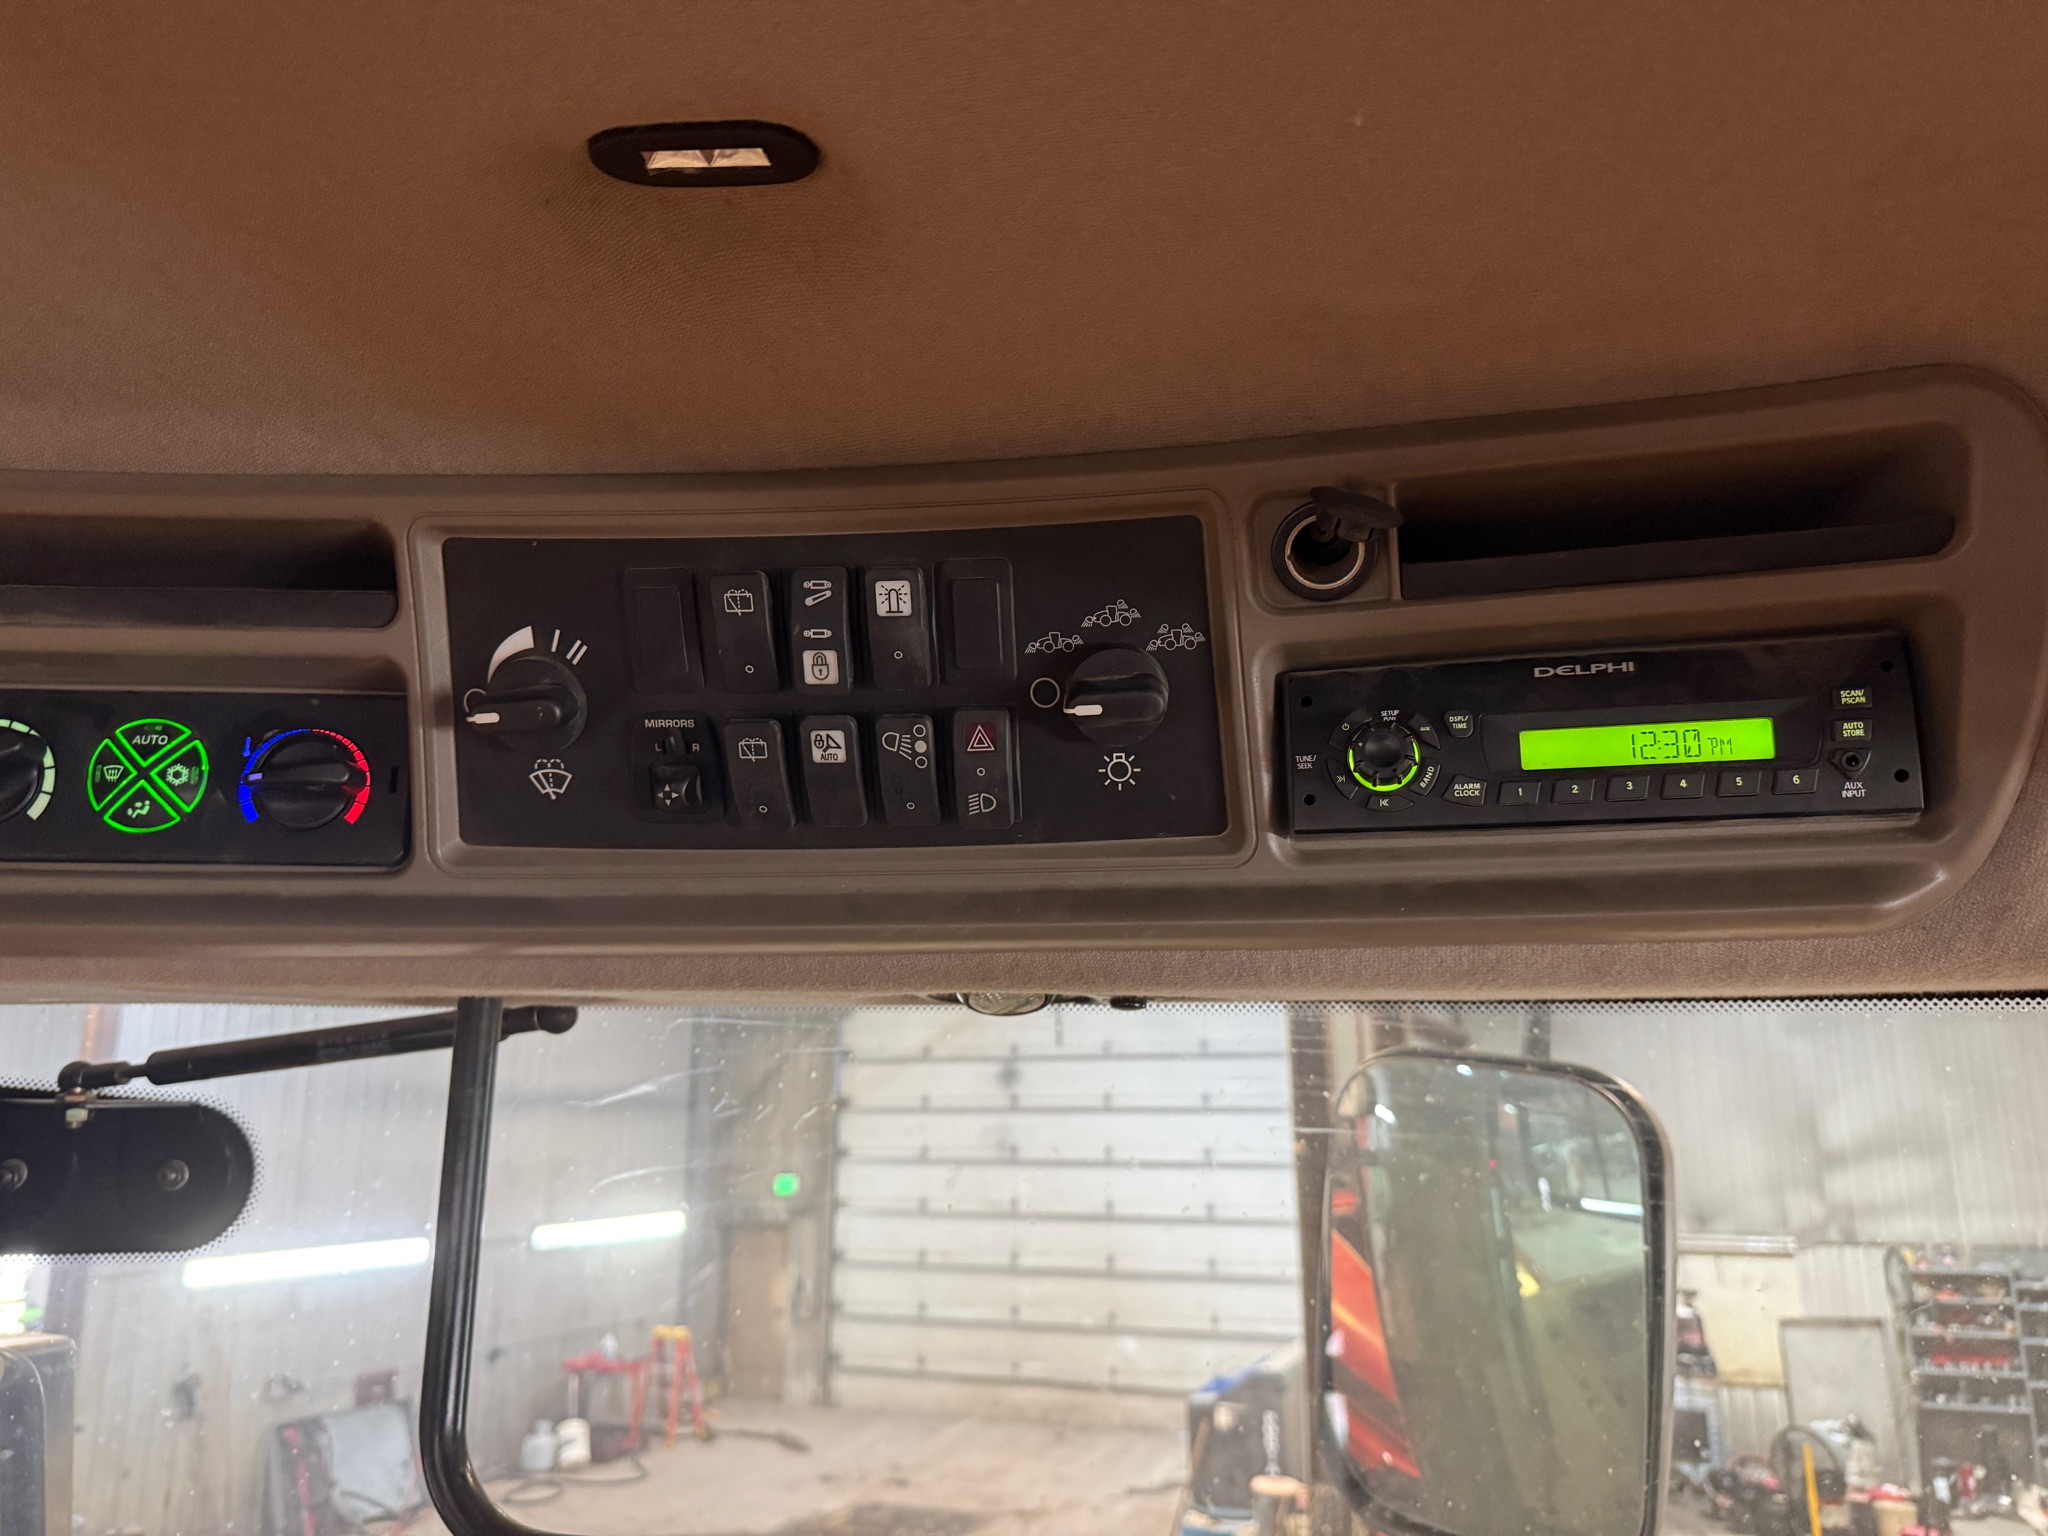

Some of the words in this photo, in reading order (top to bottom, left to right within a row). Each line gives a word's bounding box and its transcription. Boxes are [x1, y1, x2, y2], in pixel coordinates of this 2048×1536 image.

[1533, 661, 1635, 678] DELPHI
[1840, 689, 1865, 698] SCAN/
[1841, 696, 1866, 705] PSCAN
[1380, 709, 1400, 717] SETUP
[644, 719, 695, 729] MIRRORS
[1842, 721, 1864, 729] AUTO
[1842, 729, 1865, 737] STORE
[132, 735, 168, 745] AUTO
[1630, 728, 1702, 760] 12:30
[1706, 737, 1733, 756] PM
[655, 743, 662, 752] L
[692, 743, 699, 752] R
[820, 753, 839, 761] AUTO
[1295, 754, 1317, 763] TUNE/
[1297, 762, 1313, 770] SEEK
[1419, 765, 1435, 788] BAND
[1517, 787, 1523, 797] 1
[1571, 784, 1579, 794] 2
[1625, 781, 1633, 790] 3
[1679, 779, 1687, 788] 4
[1735, 777, 1743, 786] 5
[1792, 774, 1800, 785] 6
[1844, 781, 1863, 790] AUX
[1454, 789, 1480, 797] CLOCK
[1841, 789, 1866, 798] INPUT
